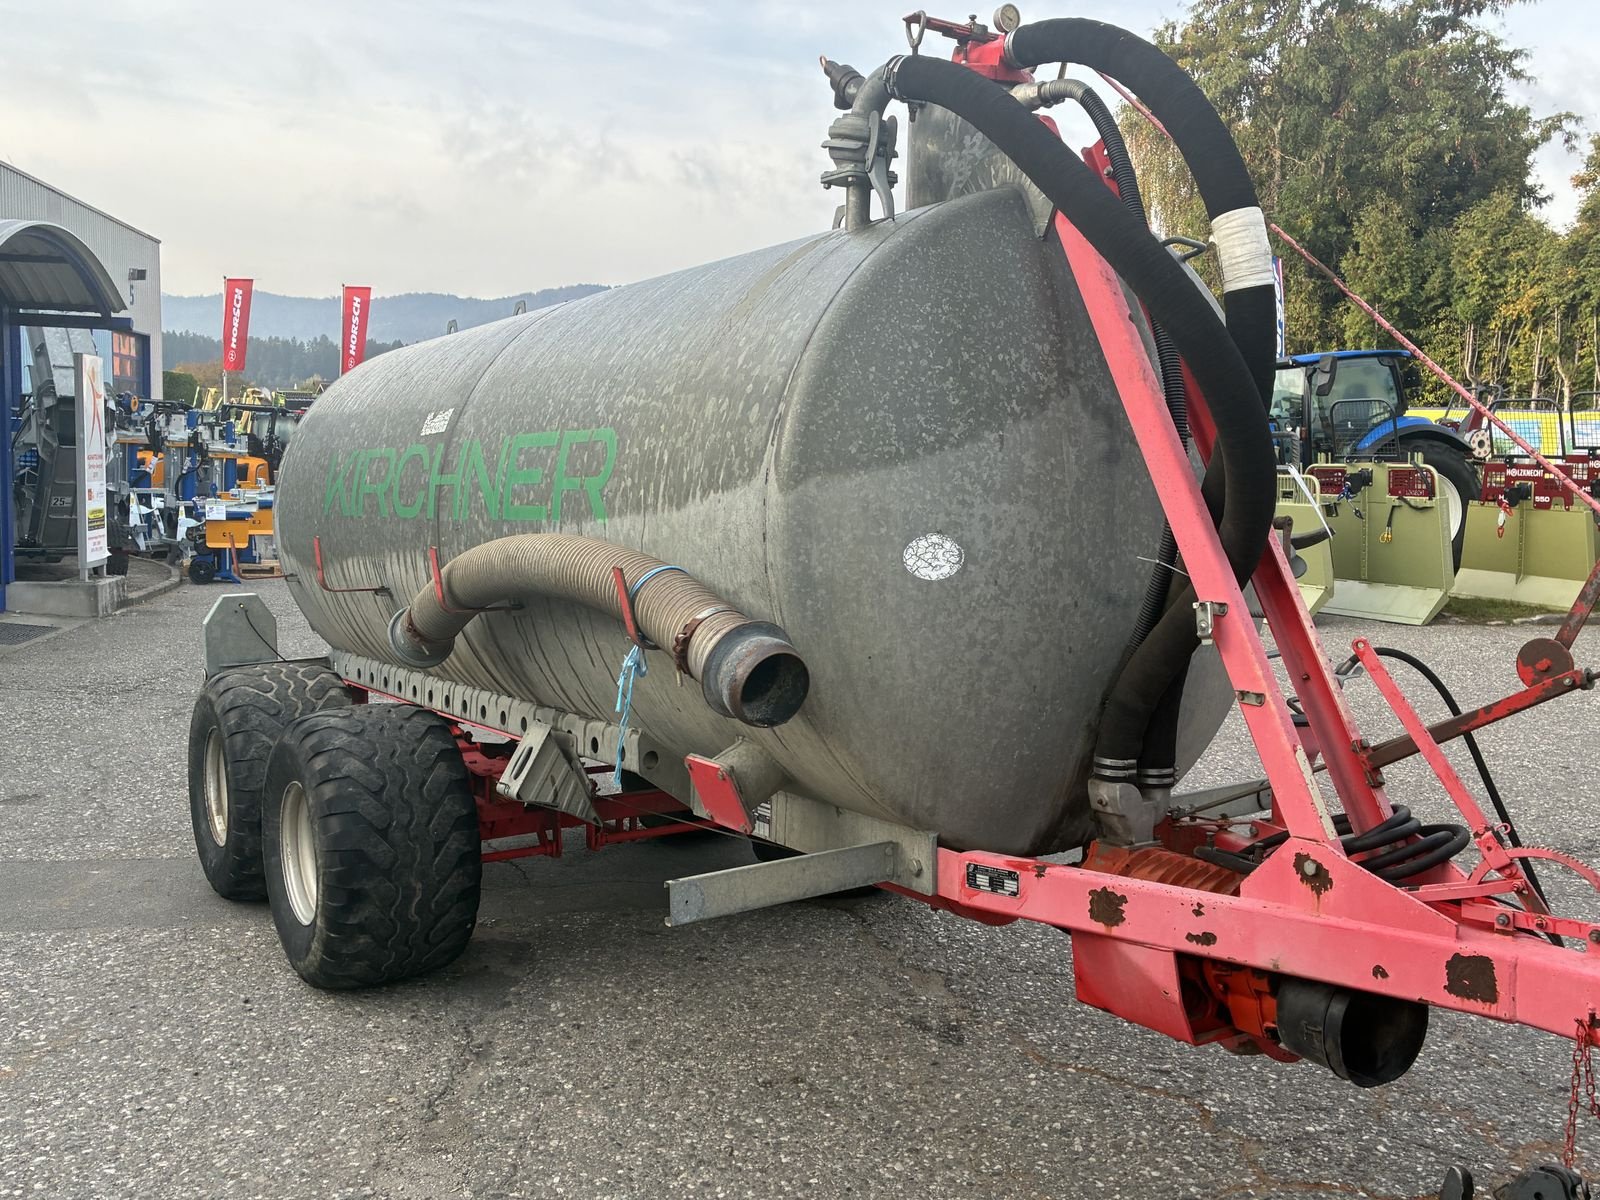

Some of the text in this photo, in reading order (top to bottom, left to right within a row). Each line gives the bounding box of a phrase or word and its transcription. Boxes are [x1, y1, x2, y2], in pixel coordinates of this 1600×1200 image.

[231, 288, 243, 349] HORSCH
[350, 296, 361, 356] HORSCH
[53, 497, 65, 506] 25
[323, 427, 619, 524] KIRCHNER
[1506, 468, 1544, 477] HOLZKNECHT
